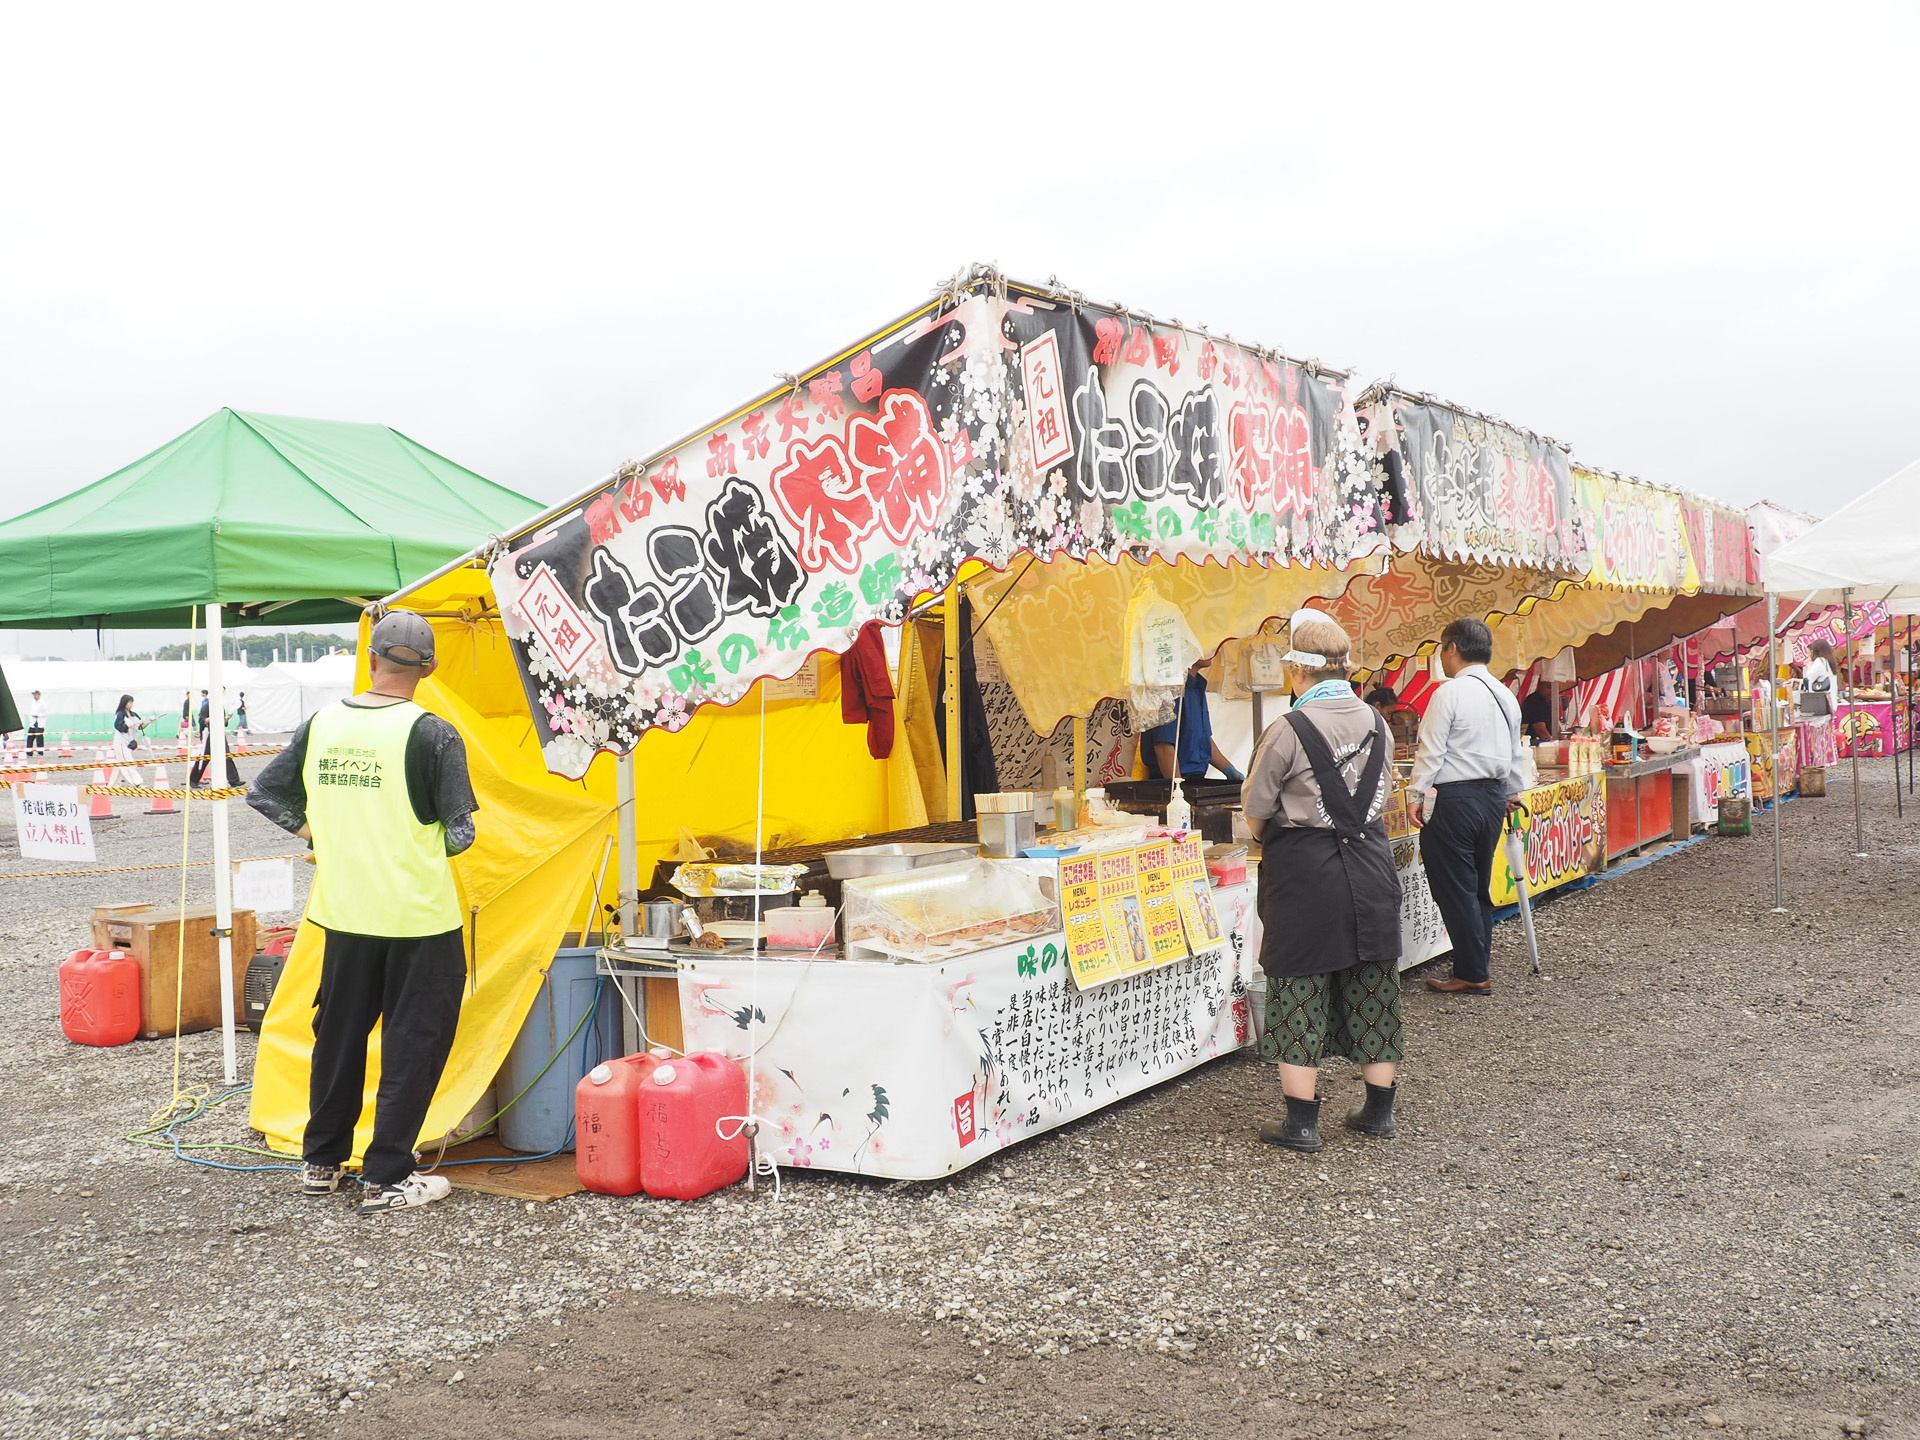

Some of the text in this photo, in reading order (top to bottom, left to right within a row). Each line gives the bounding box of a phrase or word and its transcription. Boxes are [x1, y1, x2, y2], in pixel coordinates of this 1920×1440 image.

[1032, 360, 1060, 450] 元祖
[535, 592, 580, 656] 元祖
[667, 553, 901, 699] 味の伝道師
[318, 758, 383, 774] 横浜イベント
[318, 772, 383, 788] 商業協同組合
[22, 799, 79, 818] 発電機あり
[24, 821, 87, 846] 立入禁止
[1072, 886, 1087, 897] MENU
[1147, 872, 1160, 882] MENU
[1005, 993, 1020, 1073] 是非一度
[1018, 990, 1041, 1128] 当店自慢の一品
[1034, 985, 1047, 1101] 味にこだわる
[1047, 981, 1062, 1114] 焼きにこだわり
[1059, 977, 1073, 1109] 素材にこだわり
[957, 1099, 973, 1136] 旨
